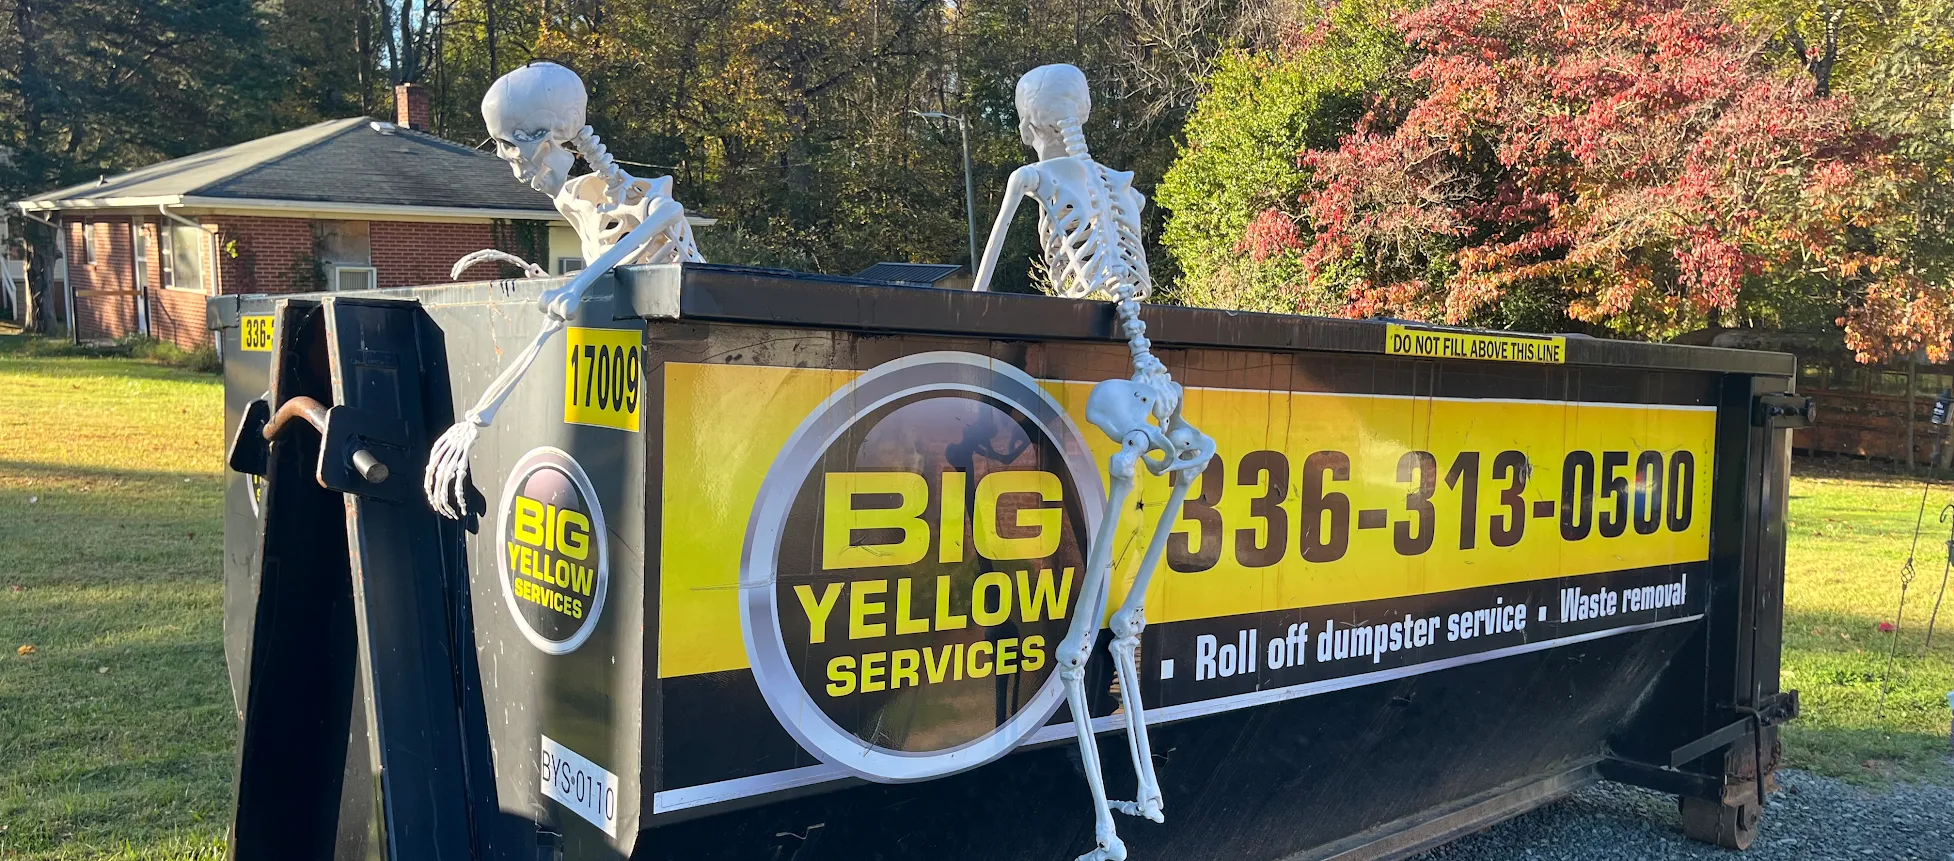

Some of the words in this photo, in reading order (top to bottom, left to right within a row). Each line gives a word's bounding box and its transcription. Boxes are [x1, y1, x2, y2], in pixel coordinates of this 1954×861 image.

[570, 344, 640, 415] 17009
[1393, 333, 1412, 354] DO
[1415, 335, 1440, 355] NOT
[1443, 337, 1467, 357] FILL
[1470, 339, 1508, 359] ABOVE
[1511, 342, 1534, 361] THIS
[1537, 344, 1560, 362] LINE
[515, 496, 590, 560] BIG
[822, 470, 1063, 570] BIG
[1166, 449, 1695, 574] 336-313-0500
[508, 541, 594, 597] YELLOW
[515, 577, 583, 619] SERVICES
[793, 567, 1075, 644] YELLOW
[1195, 628, 1258, 681] Roll
[1267, 622, 1309, 670] off
[1317, 613, 1441, 664] dumpster
[1447, 596, 1527, 642] service
[1560, 586, 1618, 623] Waste
[1622, 573, 1687, 614] removal
[825, 635, 1046, 698] SERVICES
